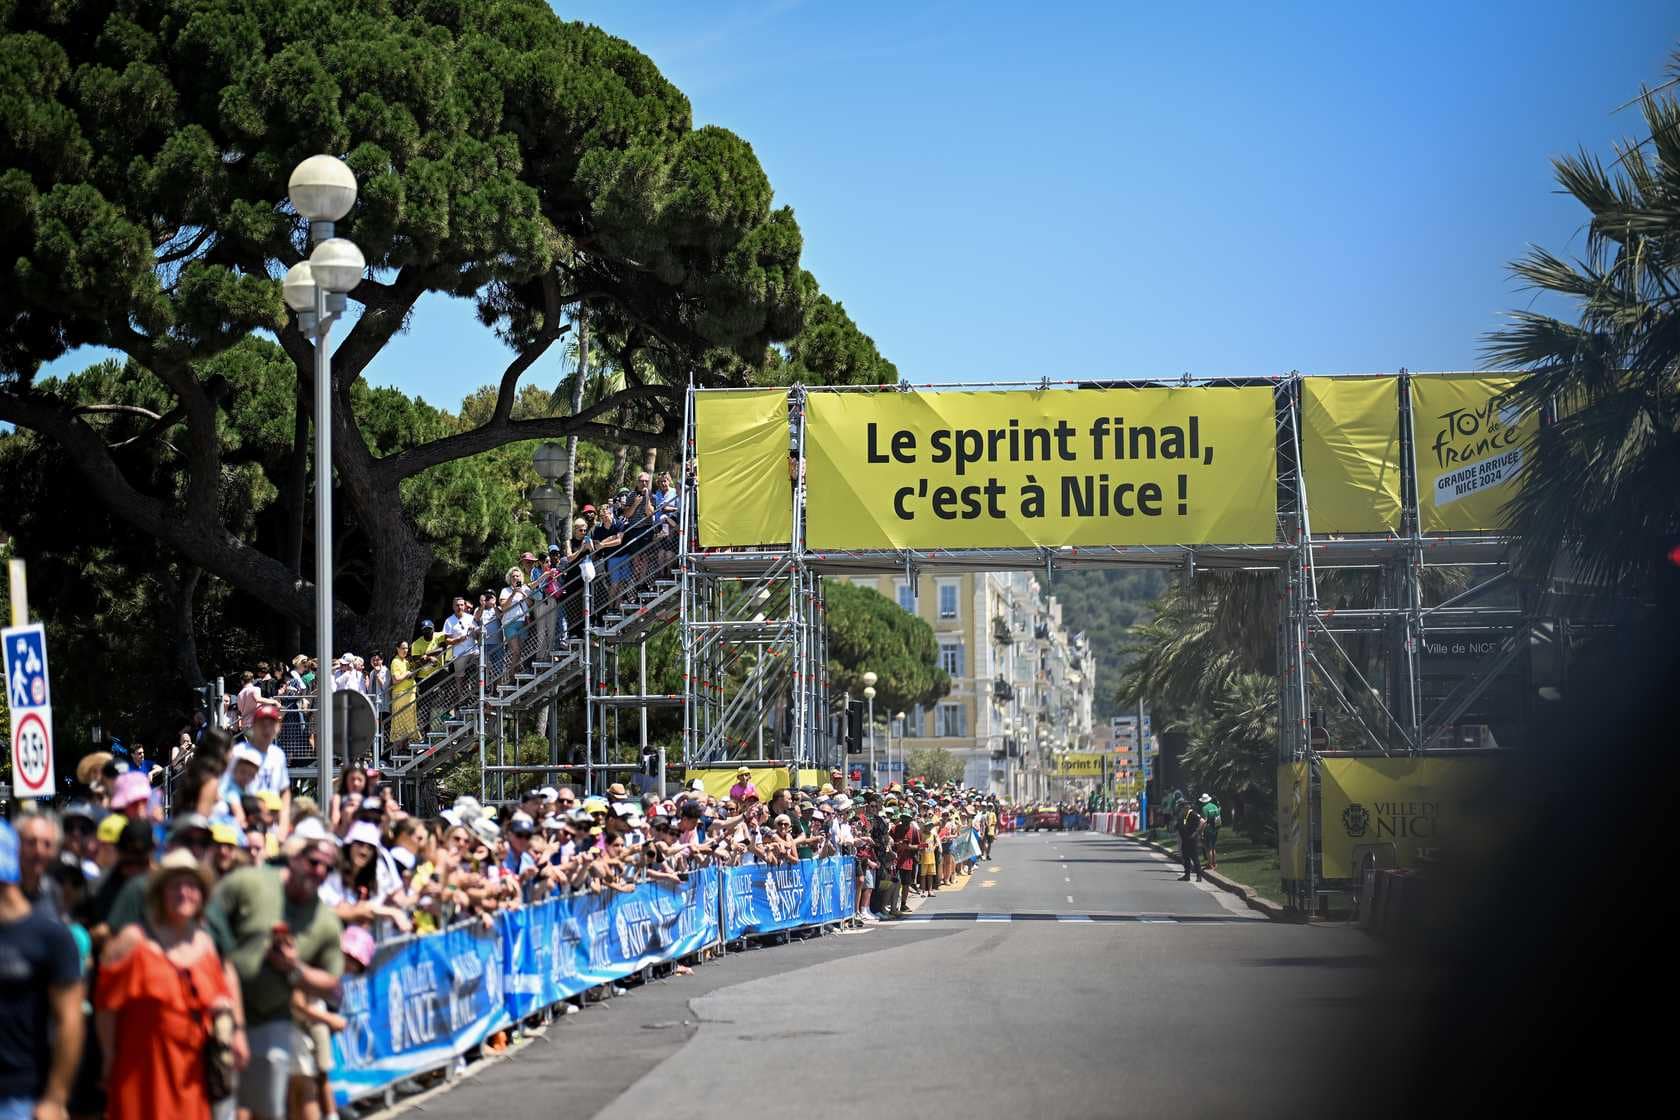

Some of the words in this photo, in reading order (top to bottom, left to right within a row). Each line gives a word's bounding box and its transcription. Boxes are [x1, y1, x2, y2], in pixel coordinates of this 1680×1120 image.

[867, 421, 916, 464] Le
[931, 419, 1076, 475] sprint
[1089, 416, 1215, 466] final,
[1438, 466, 1477, 490] GRANDE
[1455, 481, 1478, 496] NICE
[1479, 470, 1502, 488] 2024
[1020, 474, 1046, 518] à
[1061, 473, 1163, 518] Nice
[1177, 473, 1188, 517] !
[1426, 642, 1448, 654] Ville
[1451, 642, 1466, 654] de
[1375, 816, 1437, 838] NIC
